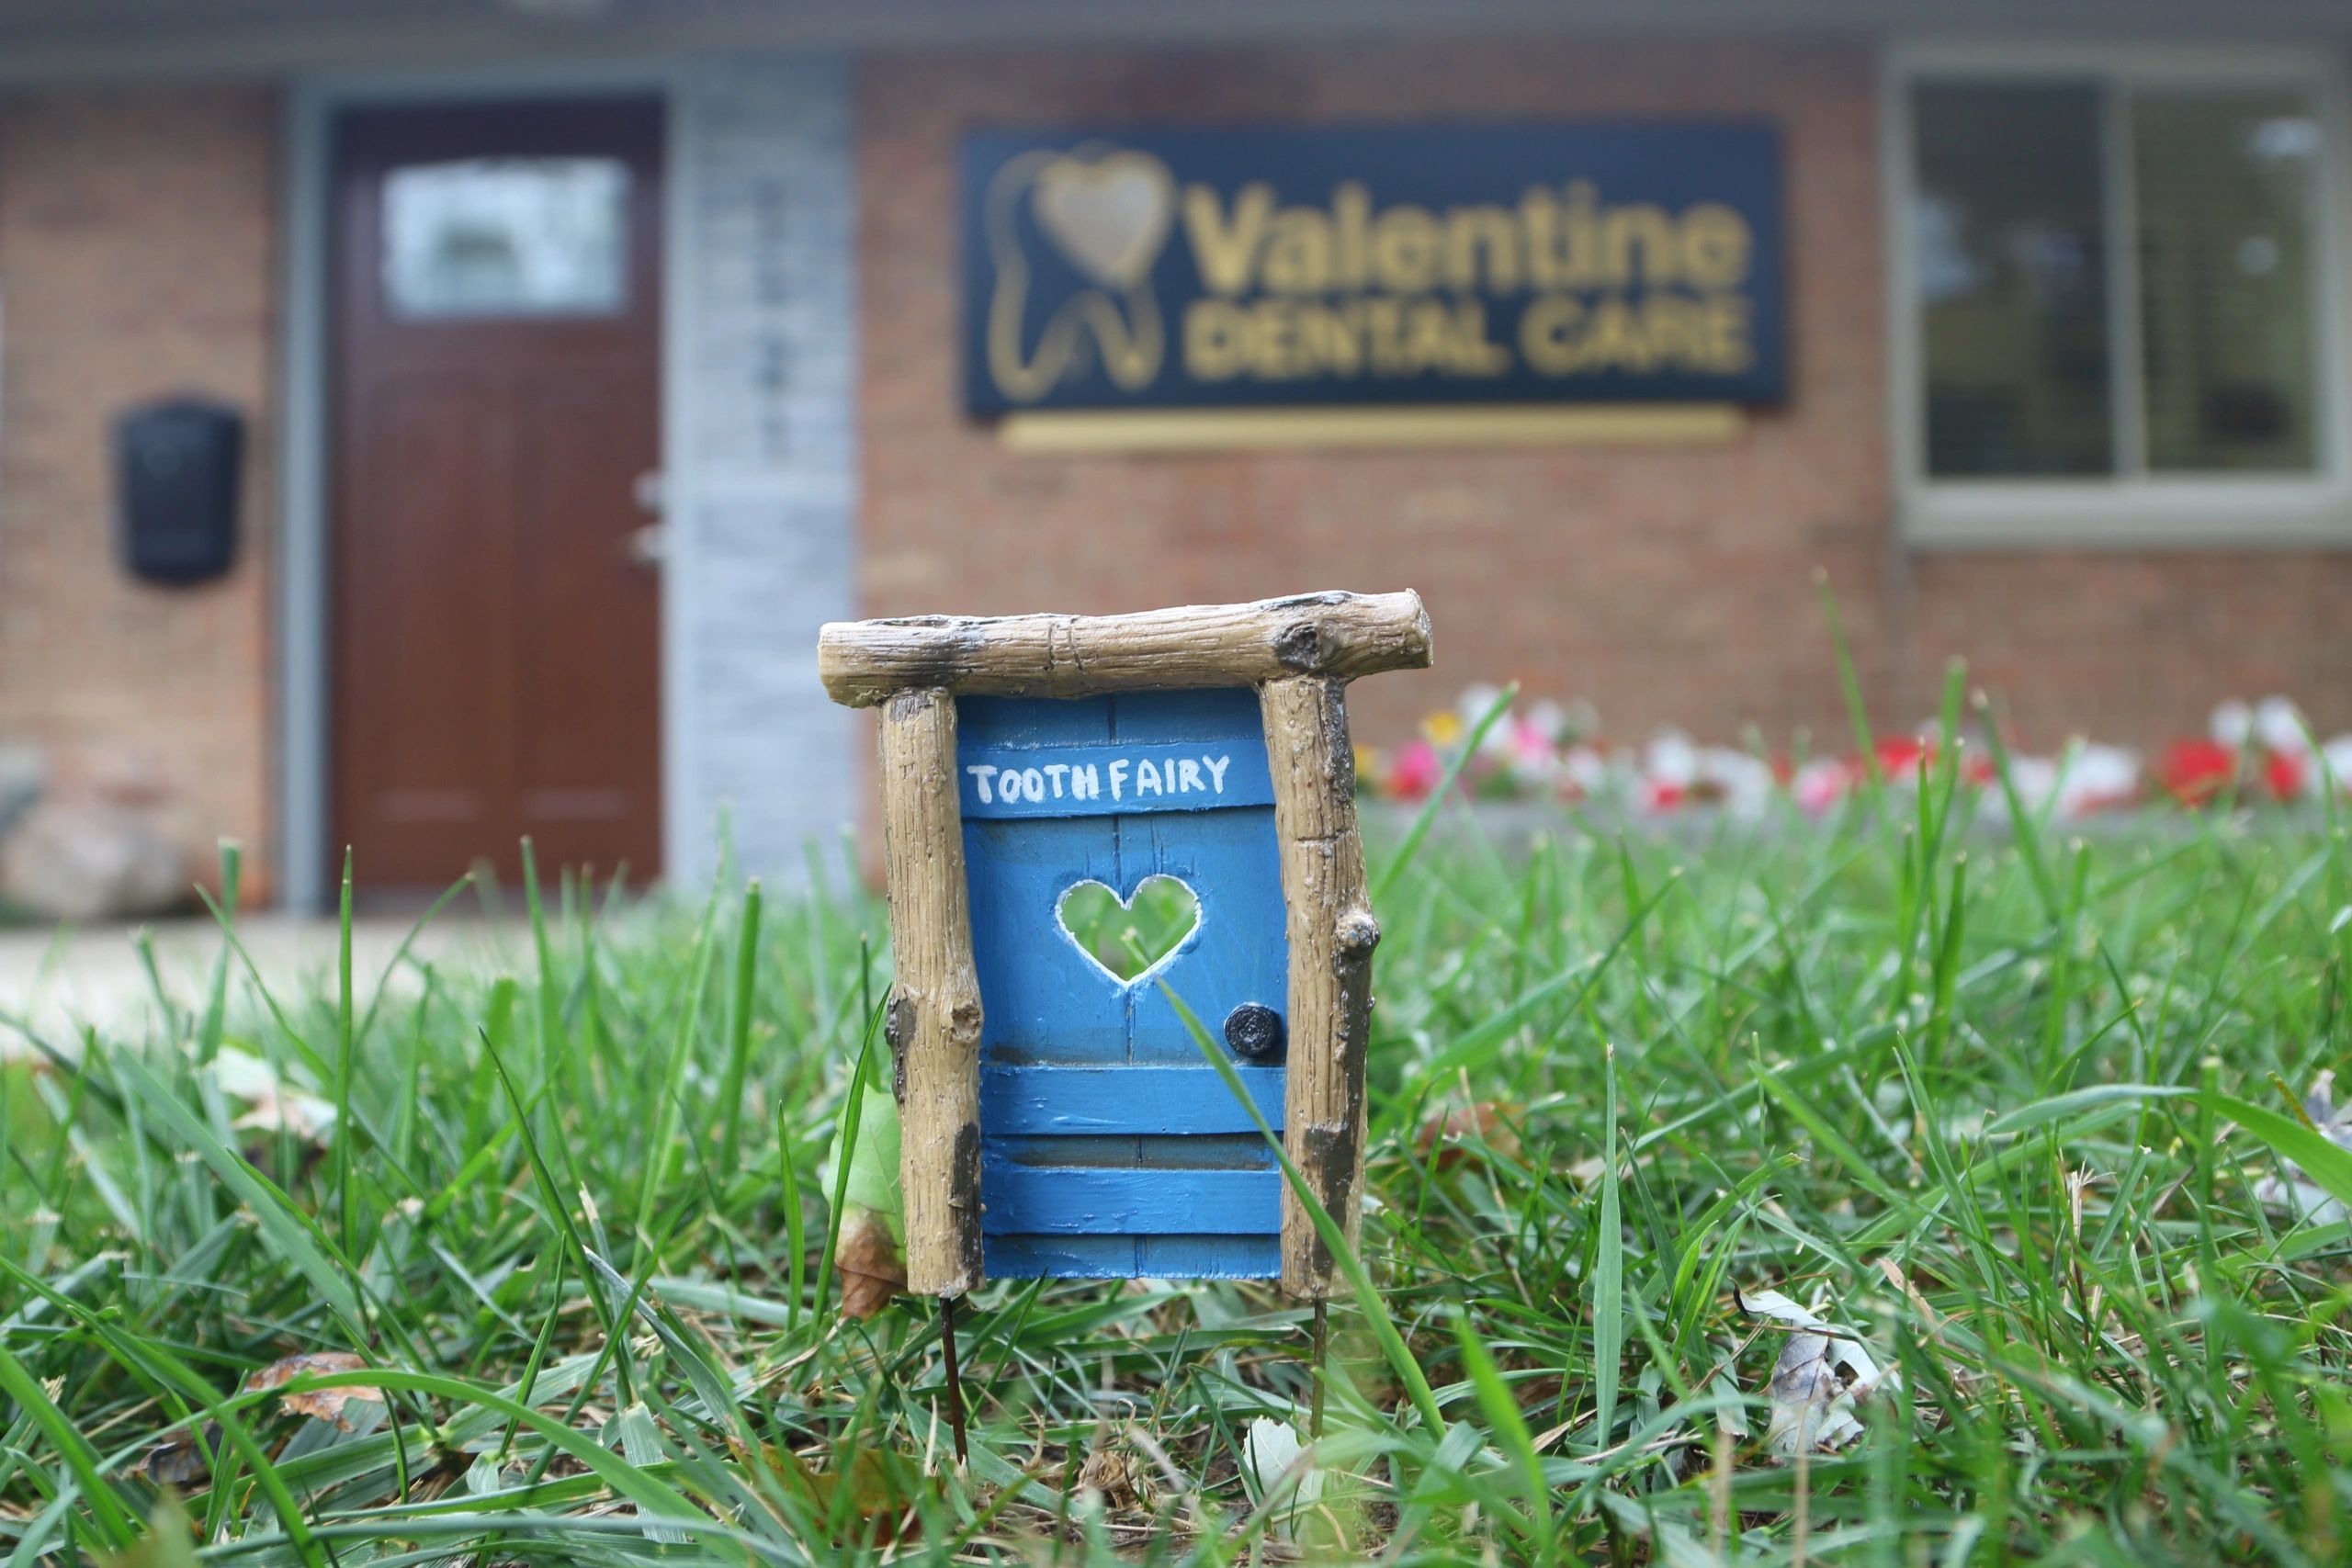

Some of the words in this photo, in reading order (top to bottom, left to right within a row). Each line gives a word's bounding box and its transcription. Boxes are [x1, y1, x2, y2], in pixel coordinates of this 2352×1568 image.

[1185, 182, 1752, 293] Valentine
[1184, 300, 1509, 378] DENTAL
[1519, 300, 1753, 376] CARE
[967, 762, 1100, 804] TOOTH
[1108, 755, 1229, 802] FAIRY
